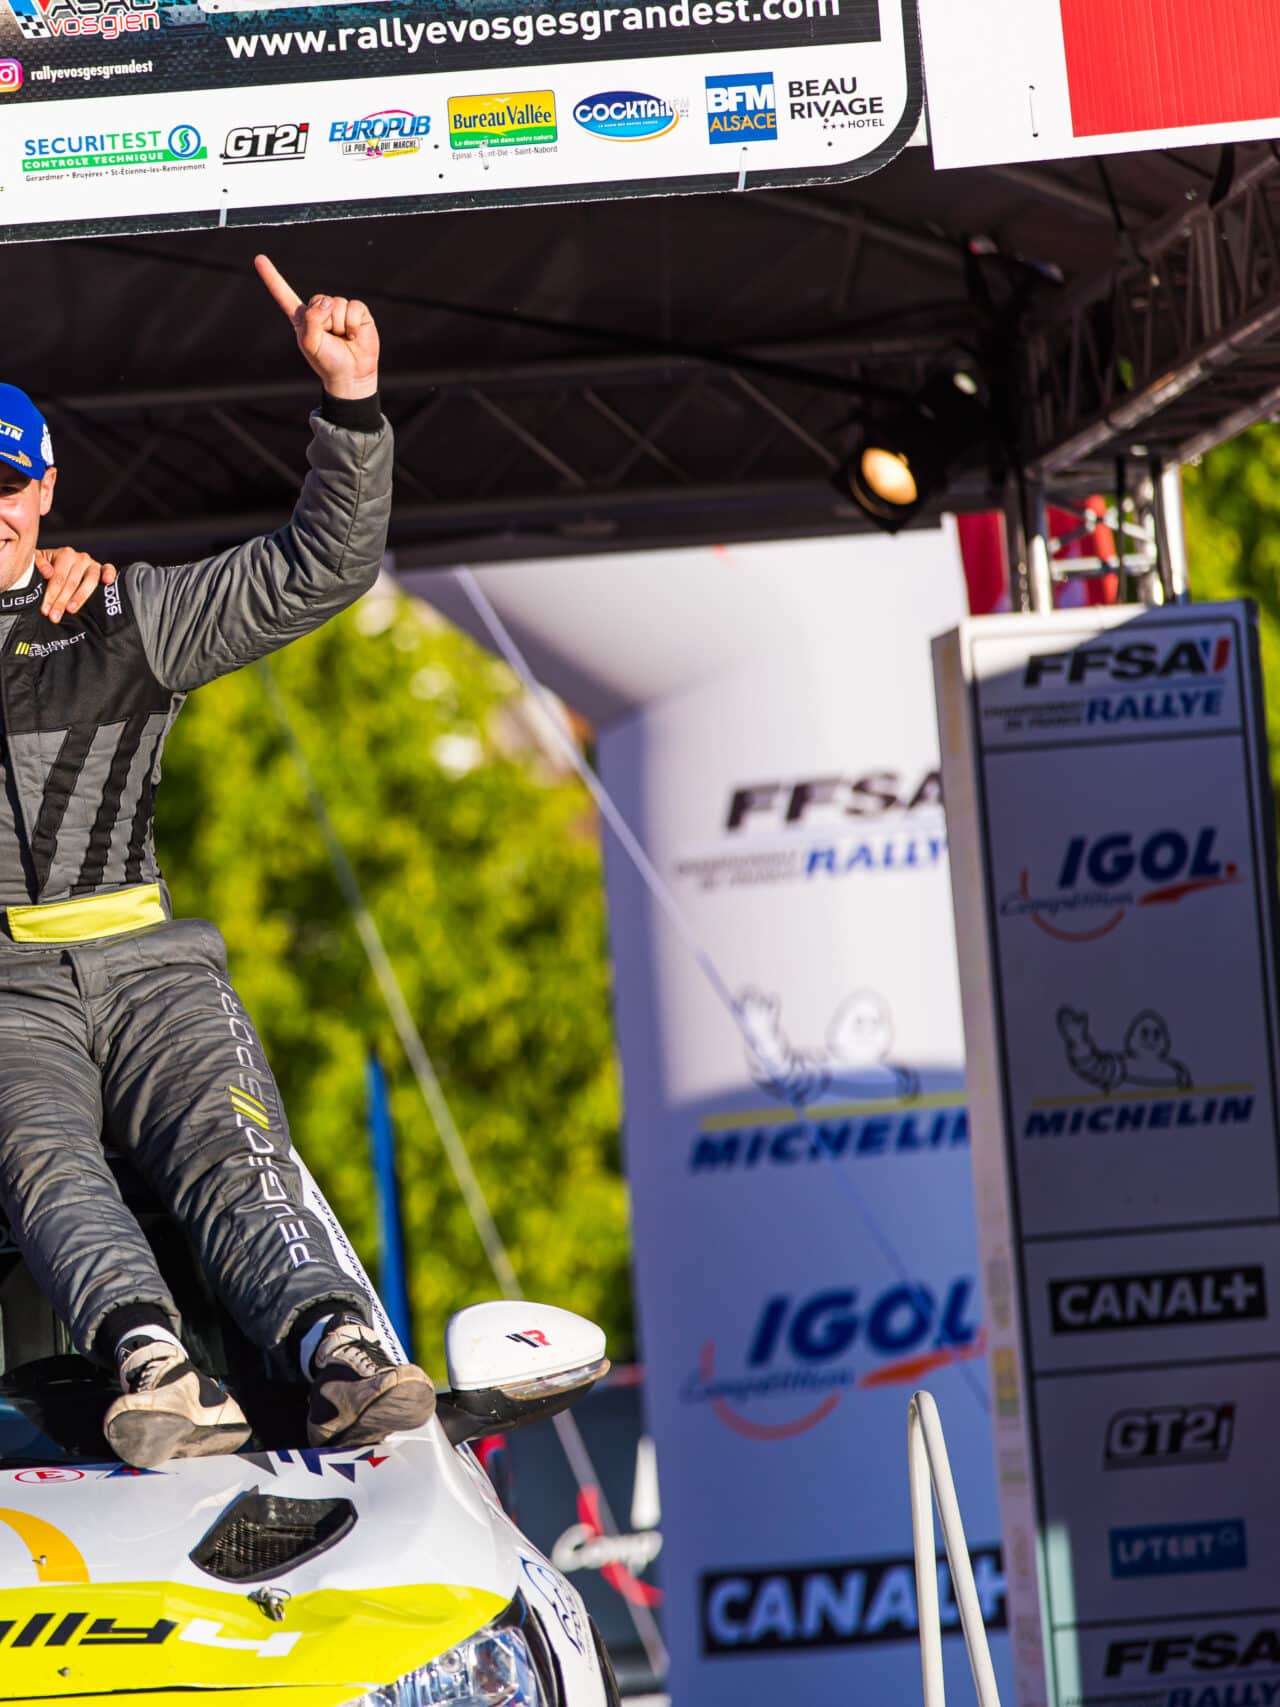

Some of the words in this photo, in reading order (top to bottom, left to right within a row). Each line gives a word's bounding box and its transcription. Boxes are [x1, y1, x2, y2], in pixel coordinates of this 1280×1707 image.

[47, 10, 161, 41] vosgien
[225, 0, 841, 60] www.rallyevosgesgrandest.com
[30, 59, 154, 83] rallyevosgesgrandest
[706, 83, 775, 114] BFM
[788, 76, 858, 98] BEAU
[452, 110, 506, 130] Bureau
[506, 104, 552, 125] Vallée
[709, 112, 777, 133] ALSACE
[790, 97, 885, 120] RIVAGE
[328, 114, 432, 143] EUROPUB
[848, 118, 886, 129] HOTEL
[24, 130, 163, 157] SECURITEST
[223, 122, 310, 160] GT2i
[24, 156, 90, 171] CONTROLE
[92, 151, 165, 166] TECHNIQUE
[1023, 639, 1207, 689] FFSA
[1086, 688, 1224, 725] RALLYE
[1024, 1095, 1256, 1139] MICHELIN
[1056, 1270, 1261, 1328] CANAL+
